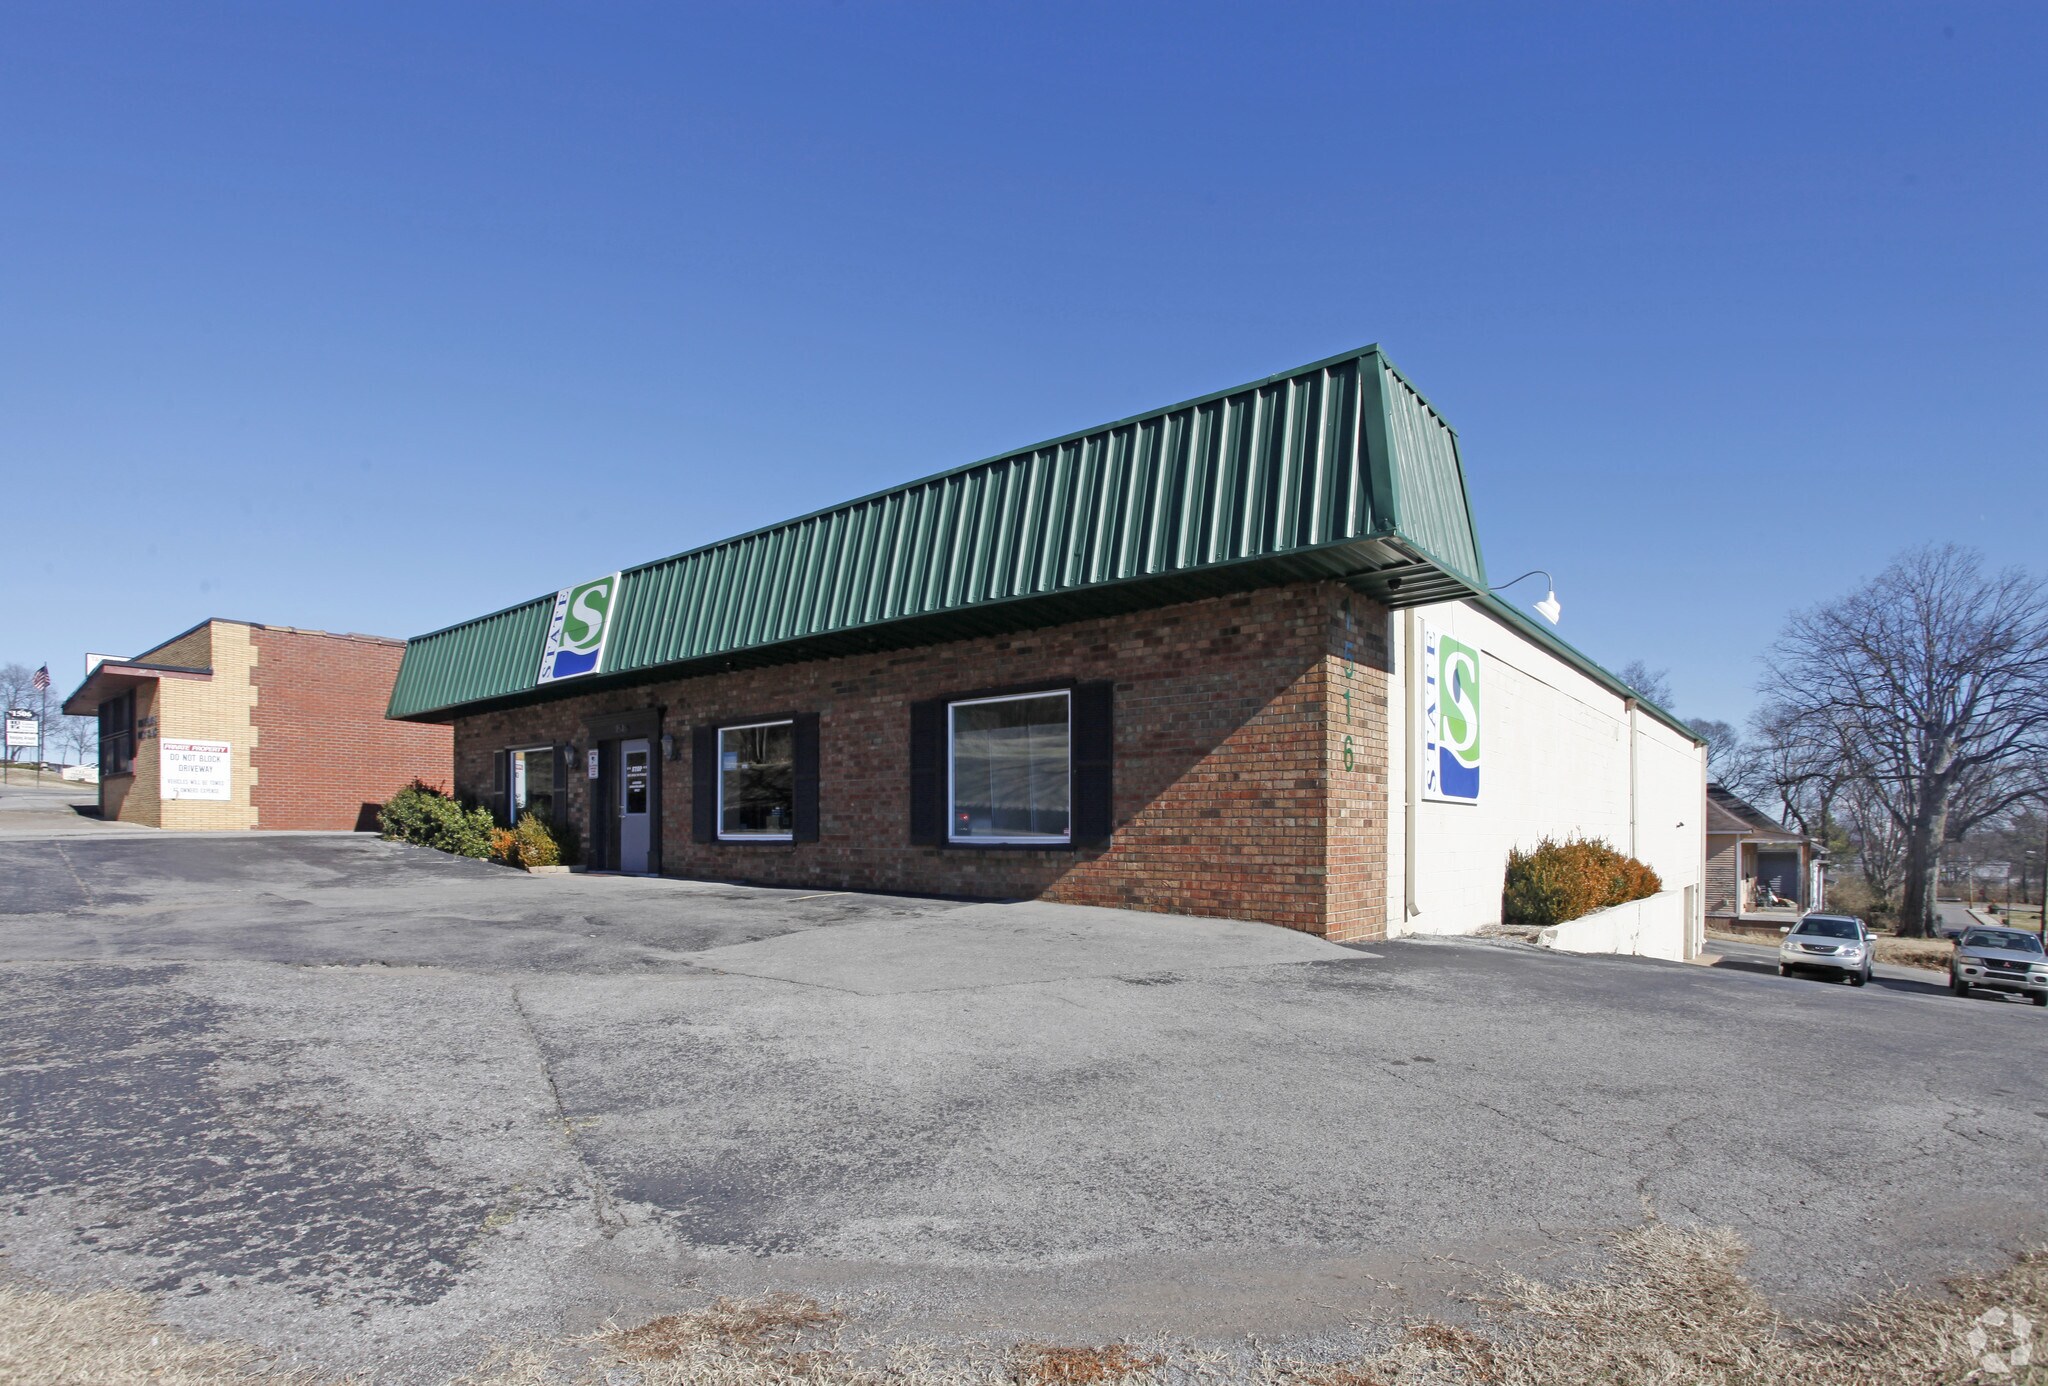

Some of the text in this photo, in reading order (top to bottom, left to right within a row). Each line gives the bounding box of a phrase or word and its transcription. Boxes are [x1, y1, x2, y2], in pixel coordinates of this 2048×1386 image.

[541, 590, 569, 680] STATE
[1343, 596, 1355, 772] 1516
[1426, 630, 1436, 793] STATE
[170, 753, 221, 763] DO NOT BLOCK
[178, 764, 213, 773] DRIVEWAY
[192, 745, 226, 753] PROPERTY
